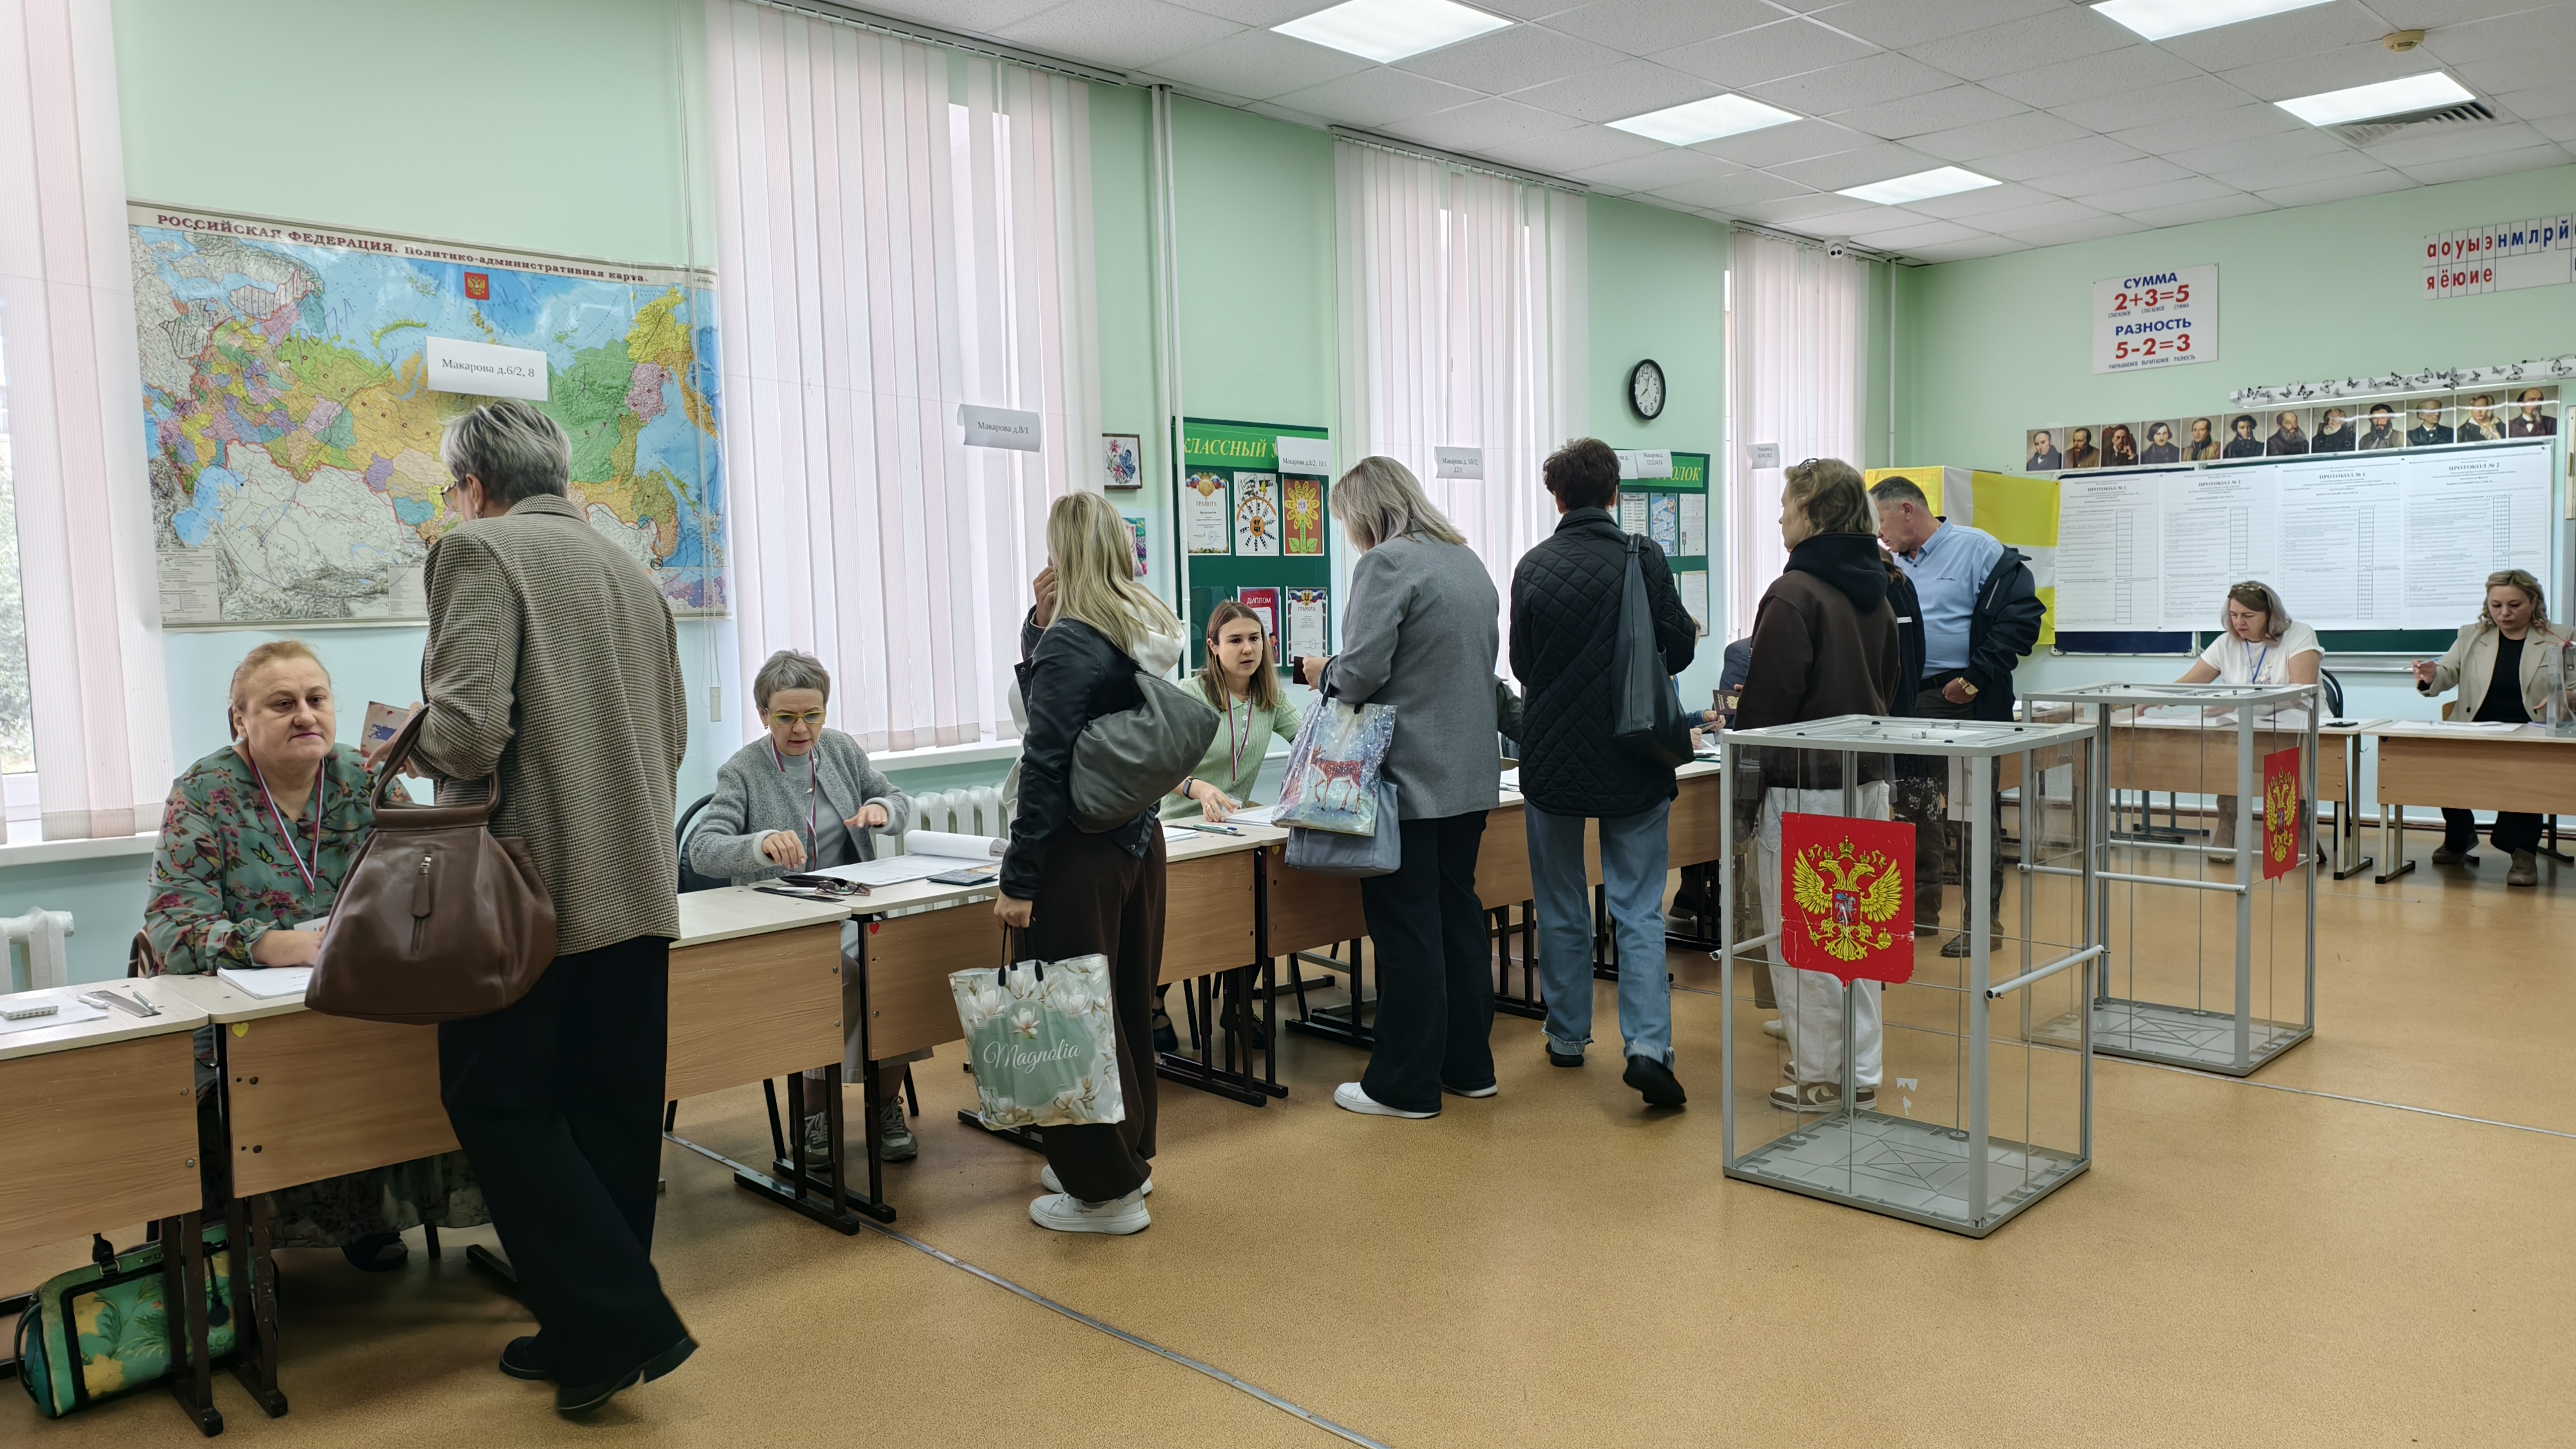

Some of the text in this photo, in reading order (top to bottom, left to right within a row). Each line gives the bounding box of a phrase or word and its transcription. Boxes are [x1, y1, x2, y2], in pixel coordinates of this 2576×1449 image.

[157, 214, 282, 239] РОССИЙСКАЯ
[288, 231, 397, 253] ФЕДЕРАЦИЯ.
[608, 272, 648, 282] карта.
[2124, 272, 2178, 289] СУММА
[2116, 318, 2192, 336] РАЗНОСТЬ
[442, 358, 535, 377] Макарова д.6/2, 8
[1643, 366, 1649, 374] 12
[1653, 377, 1657, 386] 2
[1653, 395, 1657, 403] 4
[978, 421, 1011, 433] Макарова
[1184, 438, 1267, 458] КЛАССНЫЙ
[1282, 457, 1304, 466] Макарова
[1442, 457, 1463, 465] Макарова
[1663, 466, 1701, 481] ОЛОК
[1246, 597, 1271, 605] ДИПЛОМ
[983, 1038, 1081, 1074] Magnolia
